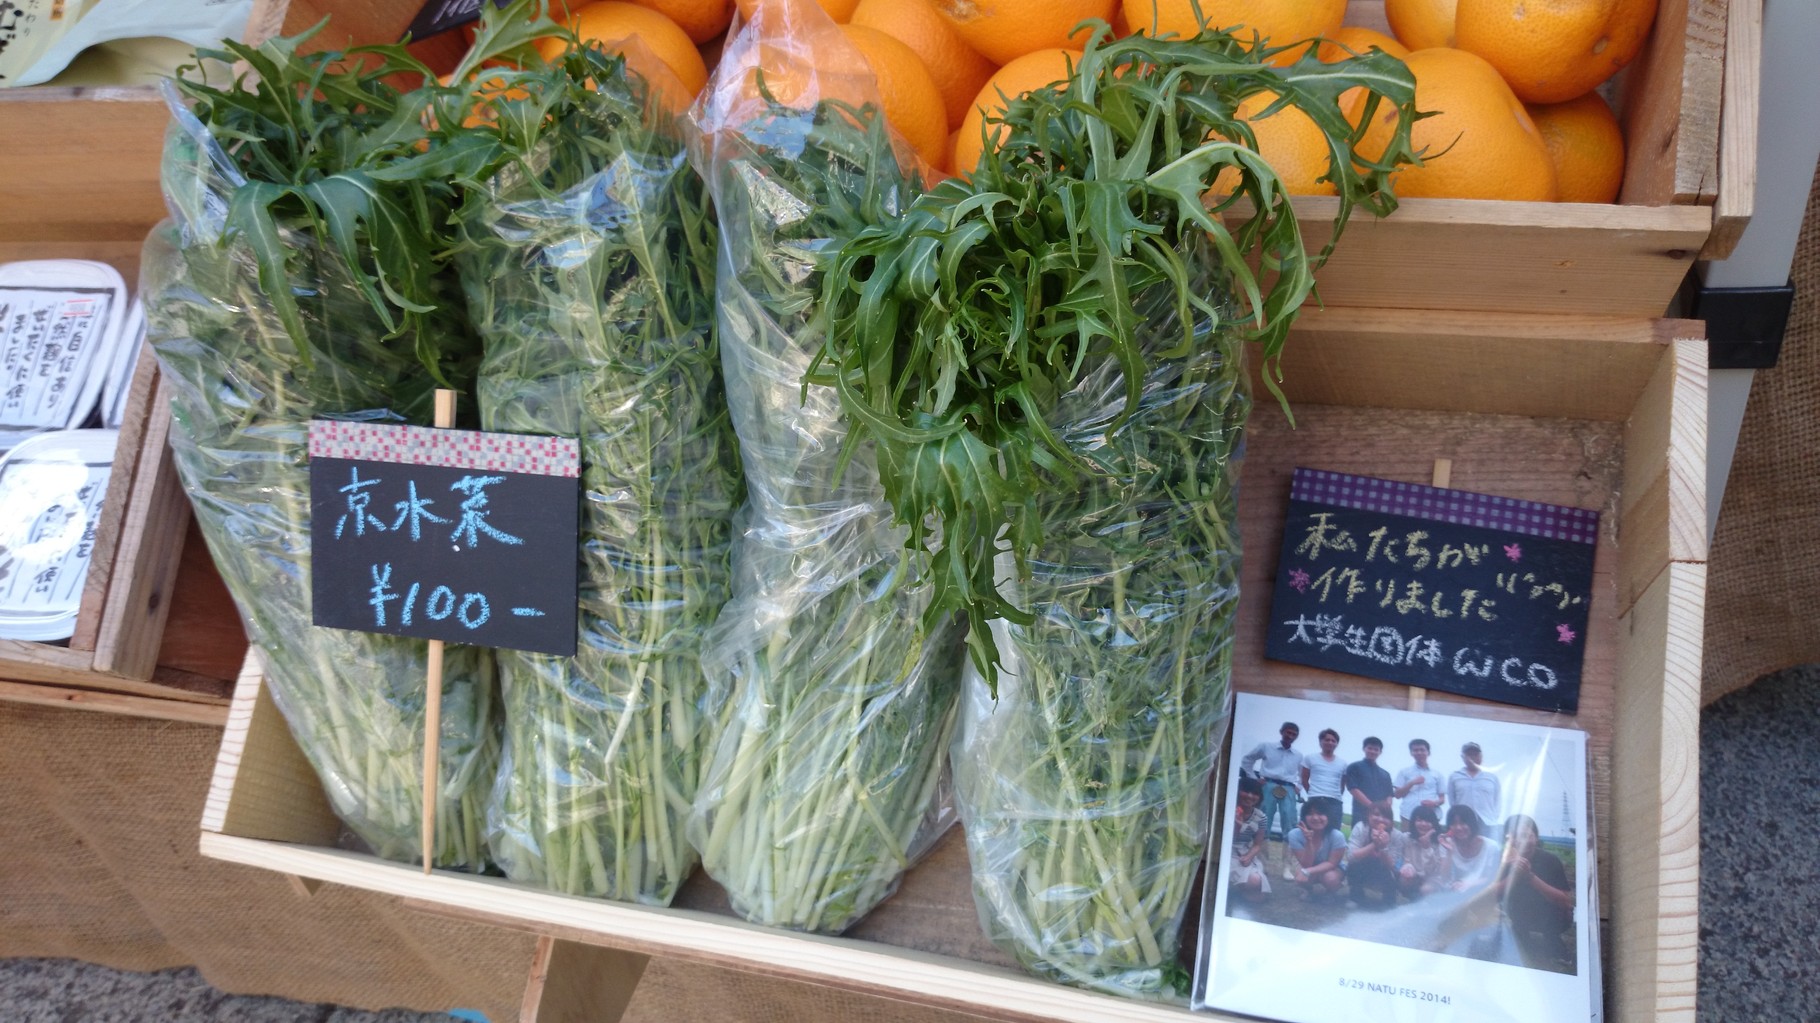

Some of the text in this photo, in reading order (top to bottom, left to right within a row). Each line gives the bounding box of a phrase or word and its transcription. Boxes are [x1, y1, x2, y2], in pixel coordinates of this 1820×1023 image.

[334, 466, 526, 549] 京水菜
[1294, 512, 1490, 571] 私たちが
[1310, 565, 1499, 622] 作りました
[1284, 613, 1559, 690] 大学生団体 WCO
[1338, 977, 1452, 1005] 8/29 NATU FES 2014!
